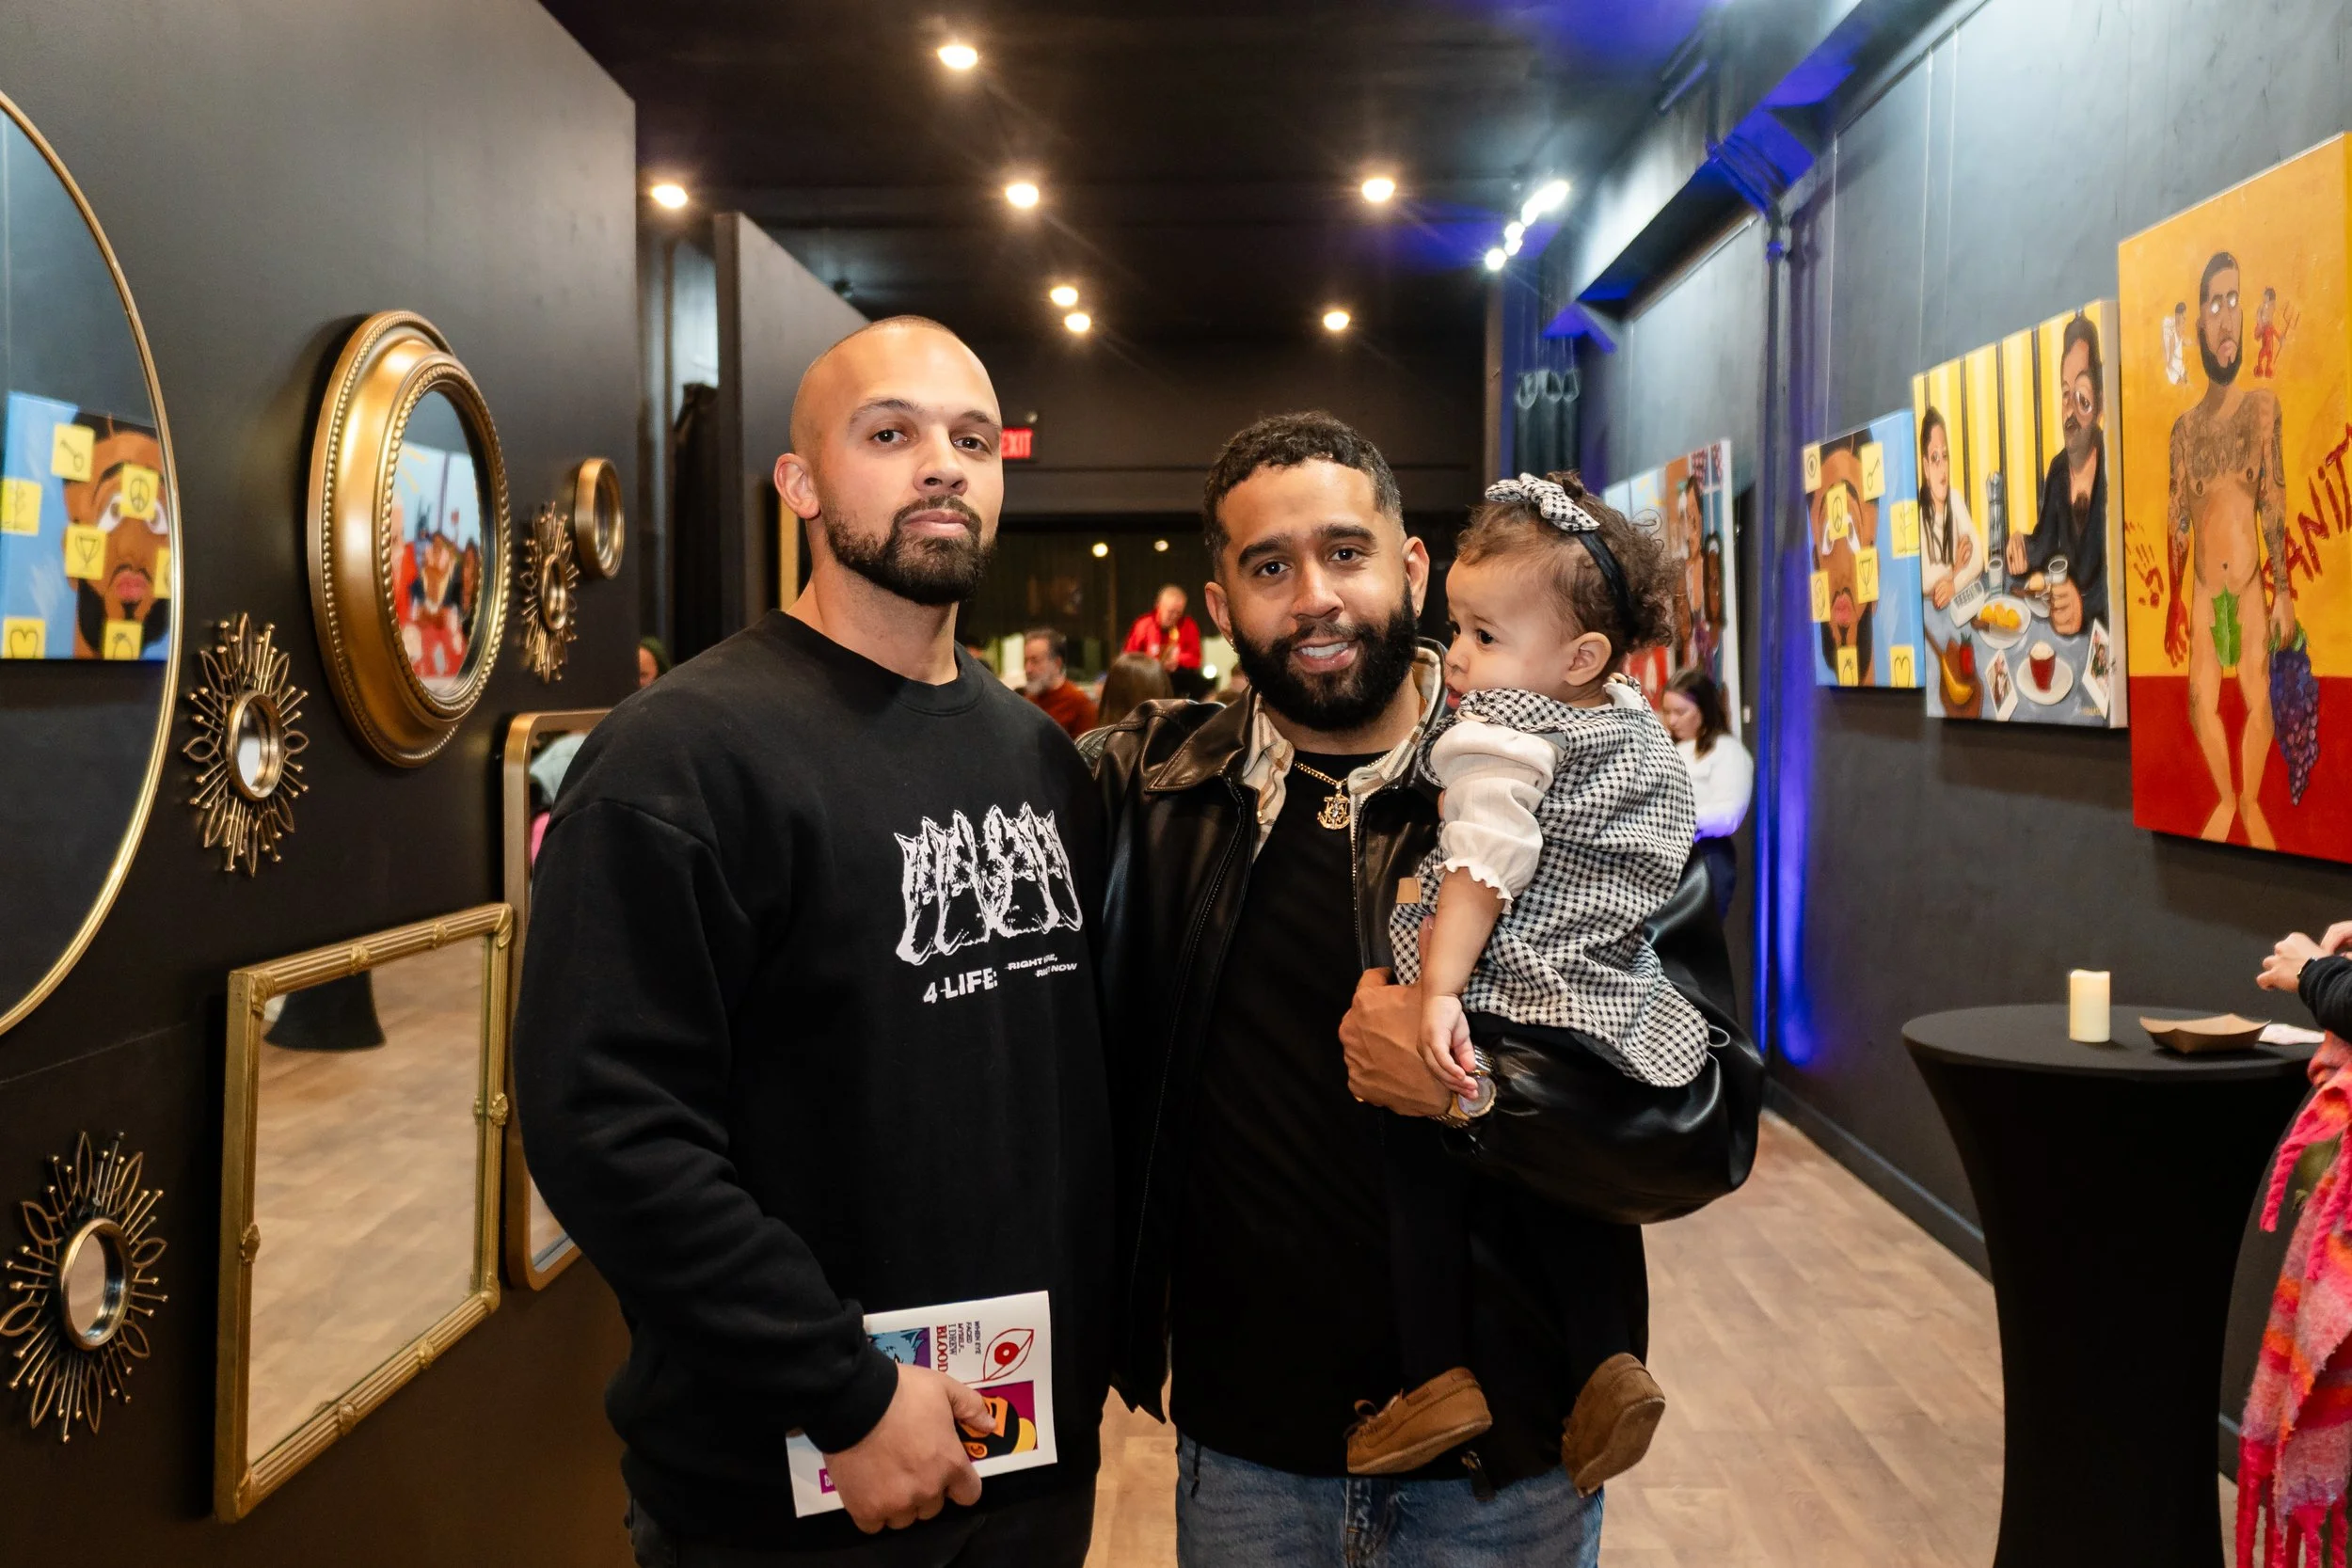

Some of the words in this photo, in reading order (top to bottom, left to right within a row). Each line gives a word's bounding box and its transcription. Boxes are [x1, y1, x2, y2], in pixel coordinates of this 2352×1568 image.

[1008, 958, 1042, 971] RIGHT
[1051, 963, 1077, 972] NOW
[923, 982, 938, 1004] 4
[936, 1325, 948, 1372] BLOOD
[948, 1329, 957, 1354] DREW
